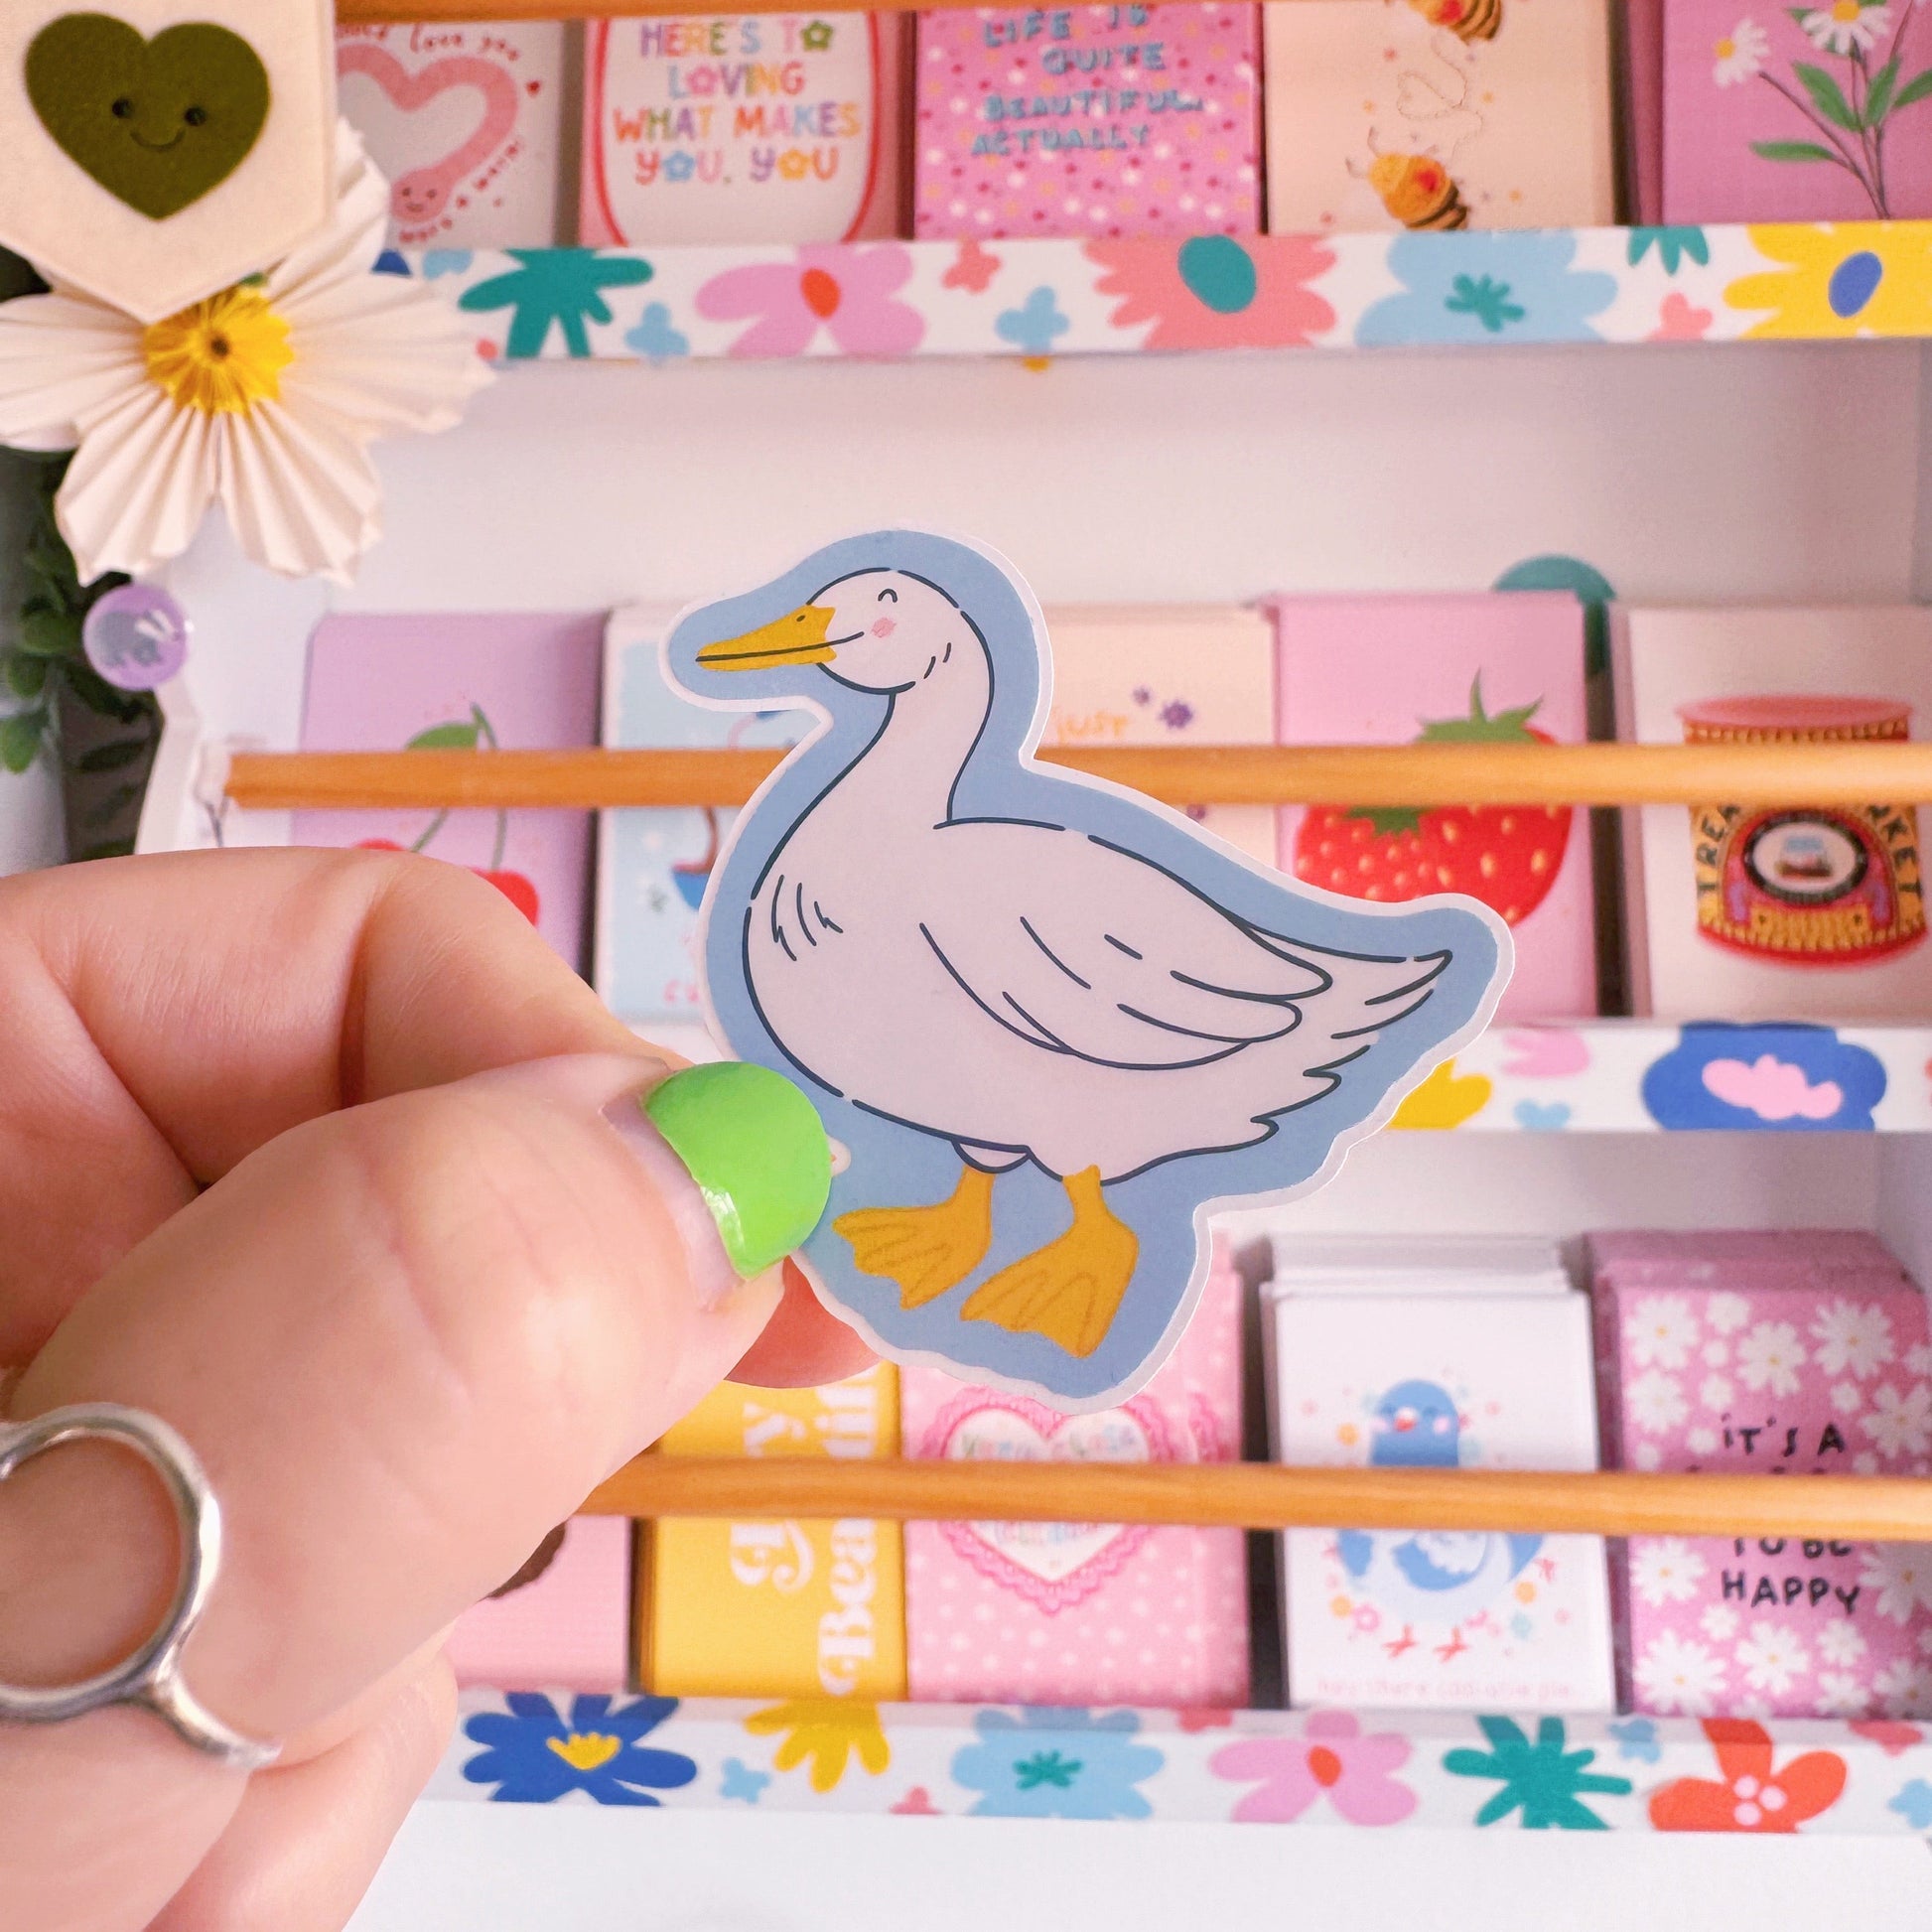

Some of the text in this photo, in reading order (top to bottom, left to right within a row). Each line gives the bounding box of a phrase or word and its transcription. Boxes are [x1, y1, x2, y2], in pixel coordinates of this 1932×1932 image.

[779, 18, 835, 55] TO
[983, 10, 1071, 48] LIFE
[1042, 42, 1167, 75] QUITE
[666, 60, 806, 100] LOVING
[613, 100, 863, 144] WHAT MAKES
[970, 123, 1151, 157] ACTUALLY
[749, 146, 840, 185] YOU
[1817, 1422, 1847, 1456] A
[1721, 1569, 1861, 1616] HAPPY
